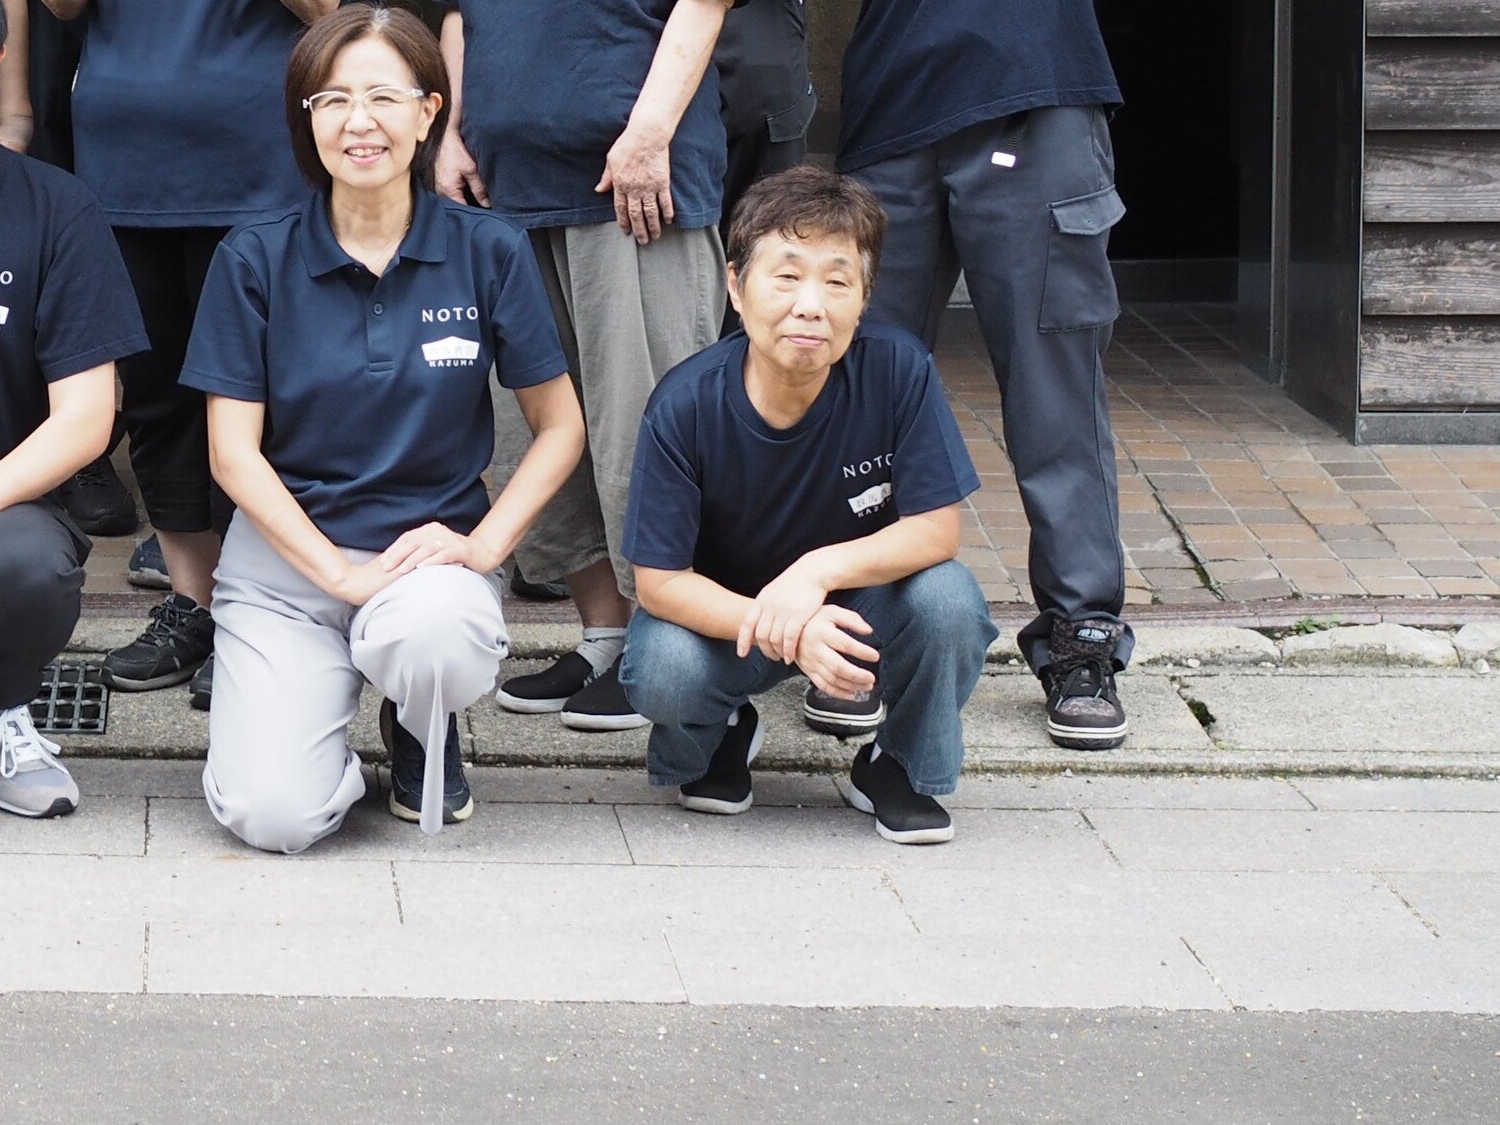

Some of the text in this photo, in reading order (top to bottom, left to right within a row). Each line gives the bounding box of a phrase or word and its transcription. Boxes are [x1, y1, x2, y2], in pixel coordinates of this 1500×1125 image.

[421, 305, 479, 323] NOTO
[429, 359, 474, 368] KAZUMA
[857, 496, 893, 518] KAZU
